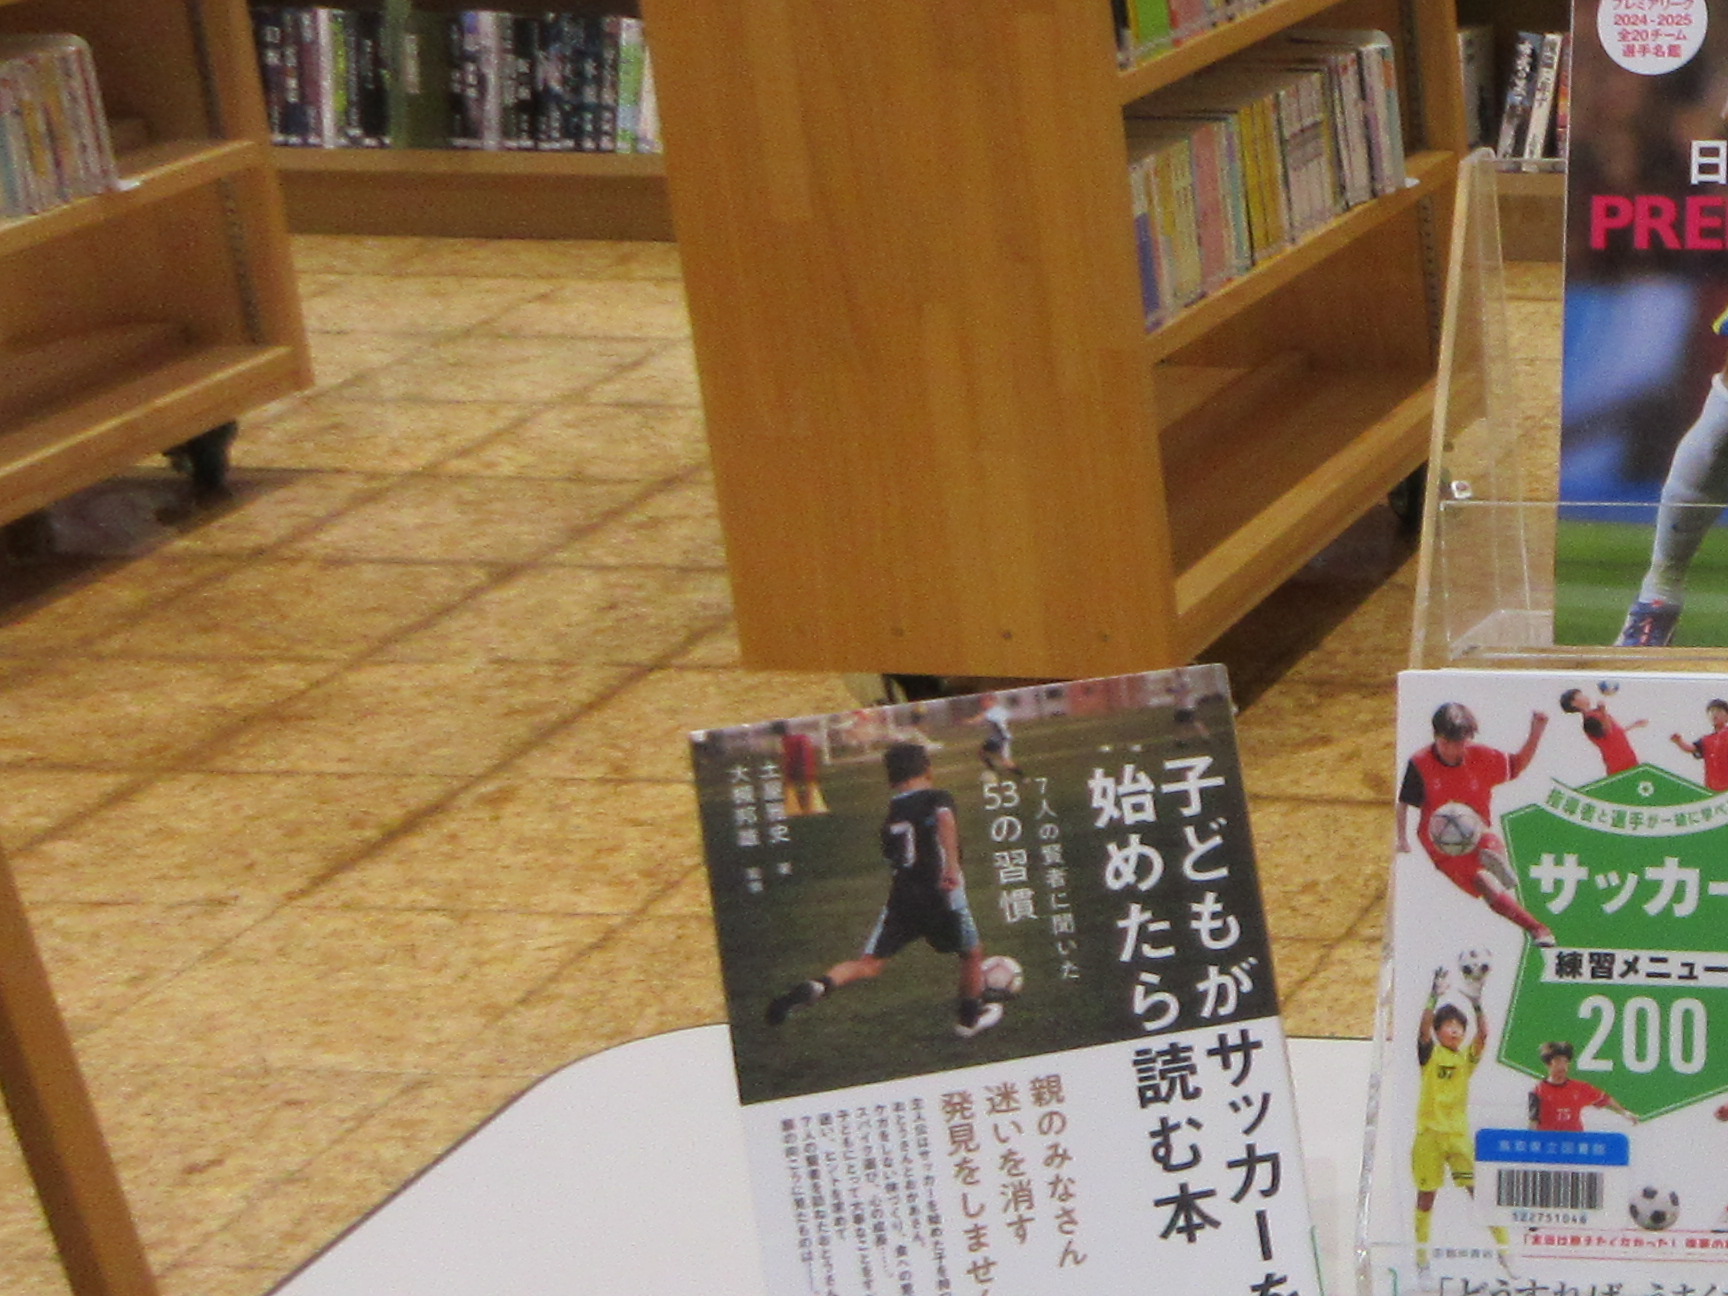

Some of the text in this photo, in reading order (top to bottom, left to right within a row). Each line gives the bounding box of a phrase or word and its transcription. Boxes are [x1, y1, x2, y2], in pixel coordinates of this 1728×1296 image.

[1613, 14, 1692, 26] 2024-2025
[1617, 29, 1687, 42] 全20チーム
[1622, 44, 1682, 58] 選手名鑑
[982, 779, 1036, 925] 53の習慣
[1088, 766, 1222, 1244] 始めたら読む本
[1576, 994, 1709, 1075] 200
[985, 1084, 1037, 1245] 迷いを消す
[1028, 1074, 1088, 1269] 親のみなさん
